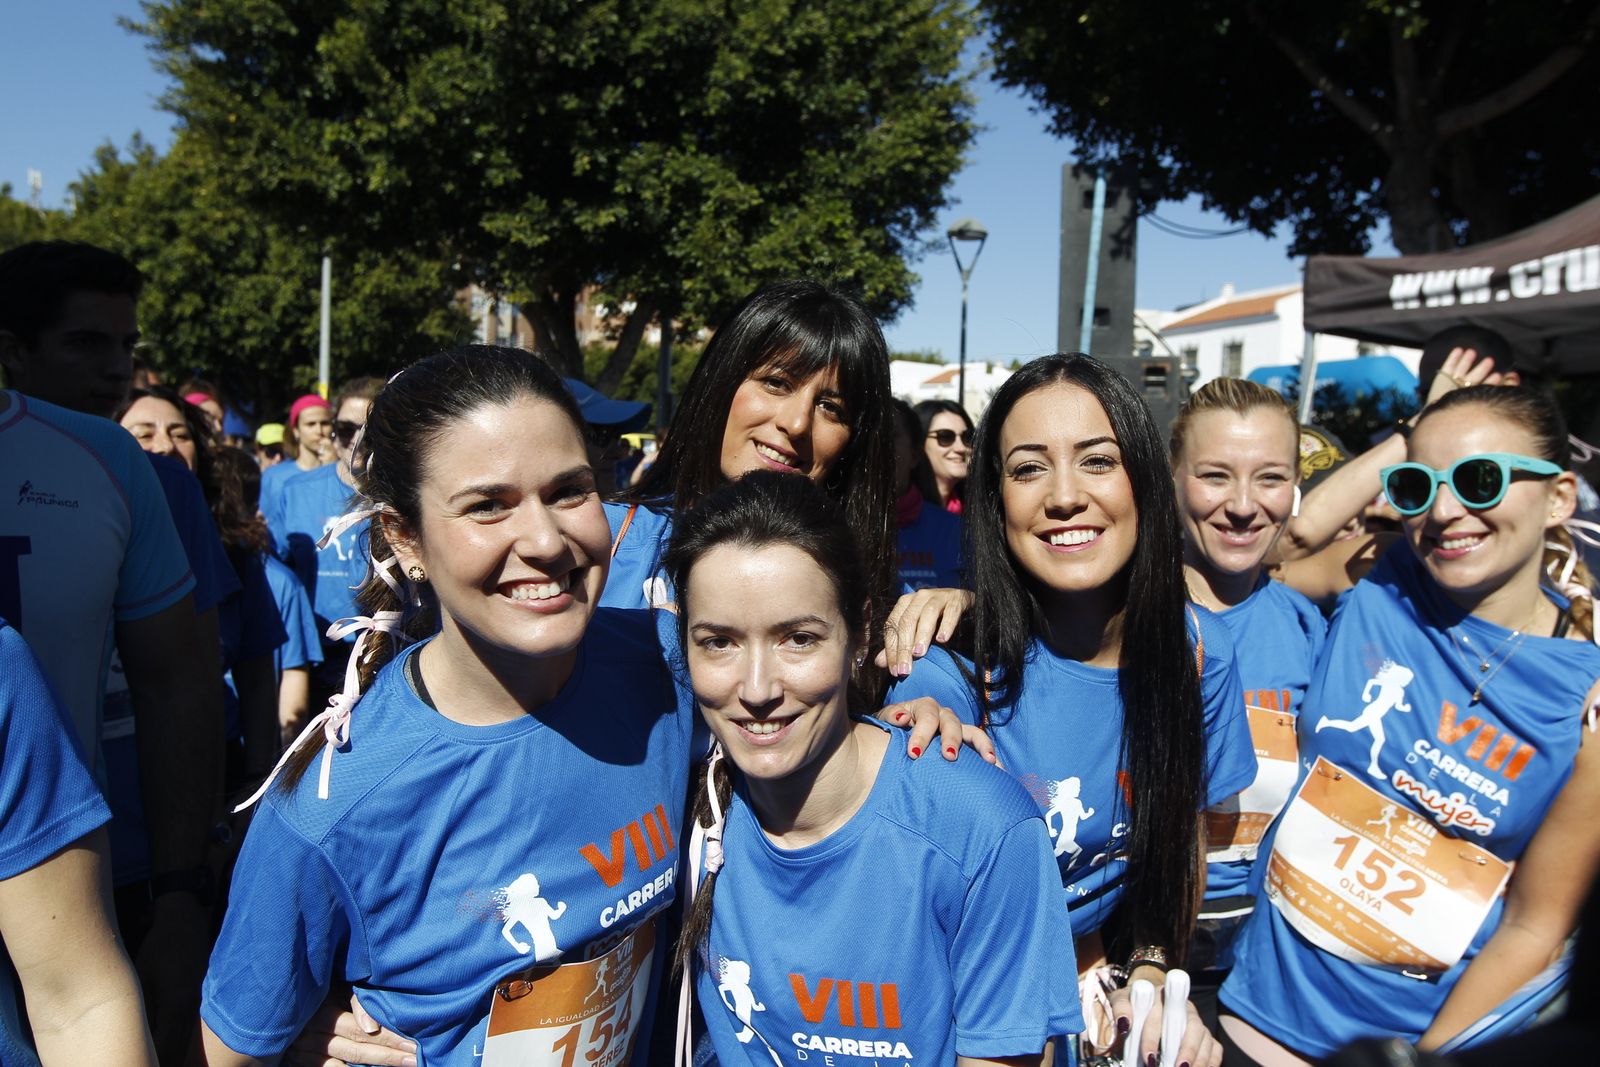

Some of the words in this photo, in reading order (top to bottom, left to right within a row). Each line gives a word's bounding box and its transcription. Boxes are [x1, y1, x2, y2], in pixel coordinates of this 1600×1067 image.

[1436, 699, 1537, 782] VIII
[1413, 739, 1509, 806] CARRERA
[579, 804, 675, 888] VIII
[1407, 813, 1437, 838] VIII
[1334, 835, 1426, 916] 152
[1339, 877, 1382, 911] OLAYA
[540, 1017, 552, 1025] LA
[555, 1004, 600, 1023] IGUALDAD
[552, 983, 634, 1067] 154
[788, 973, 902, 1029] VIII
[792, 1032, 913, 1059] CARRERA
